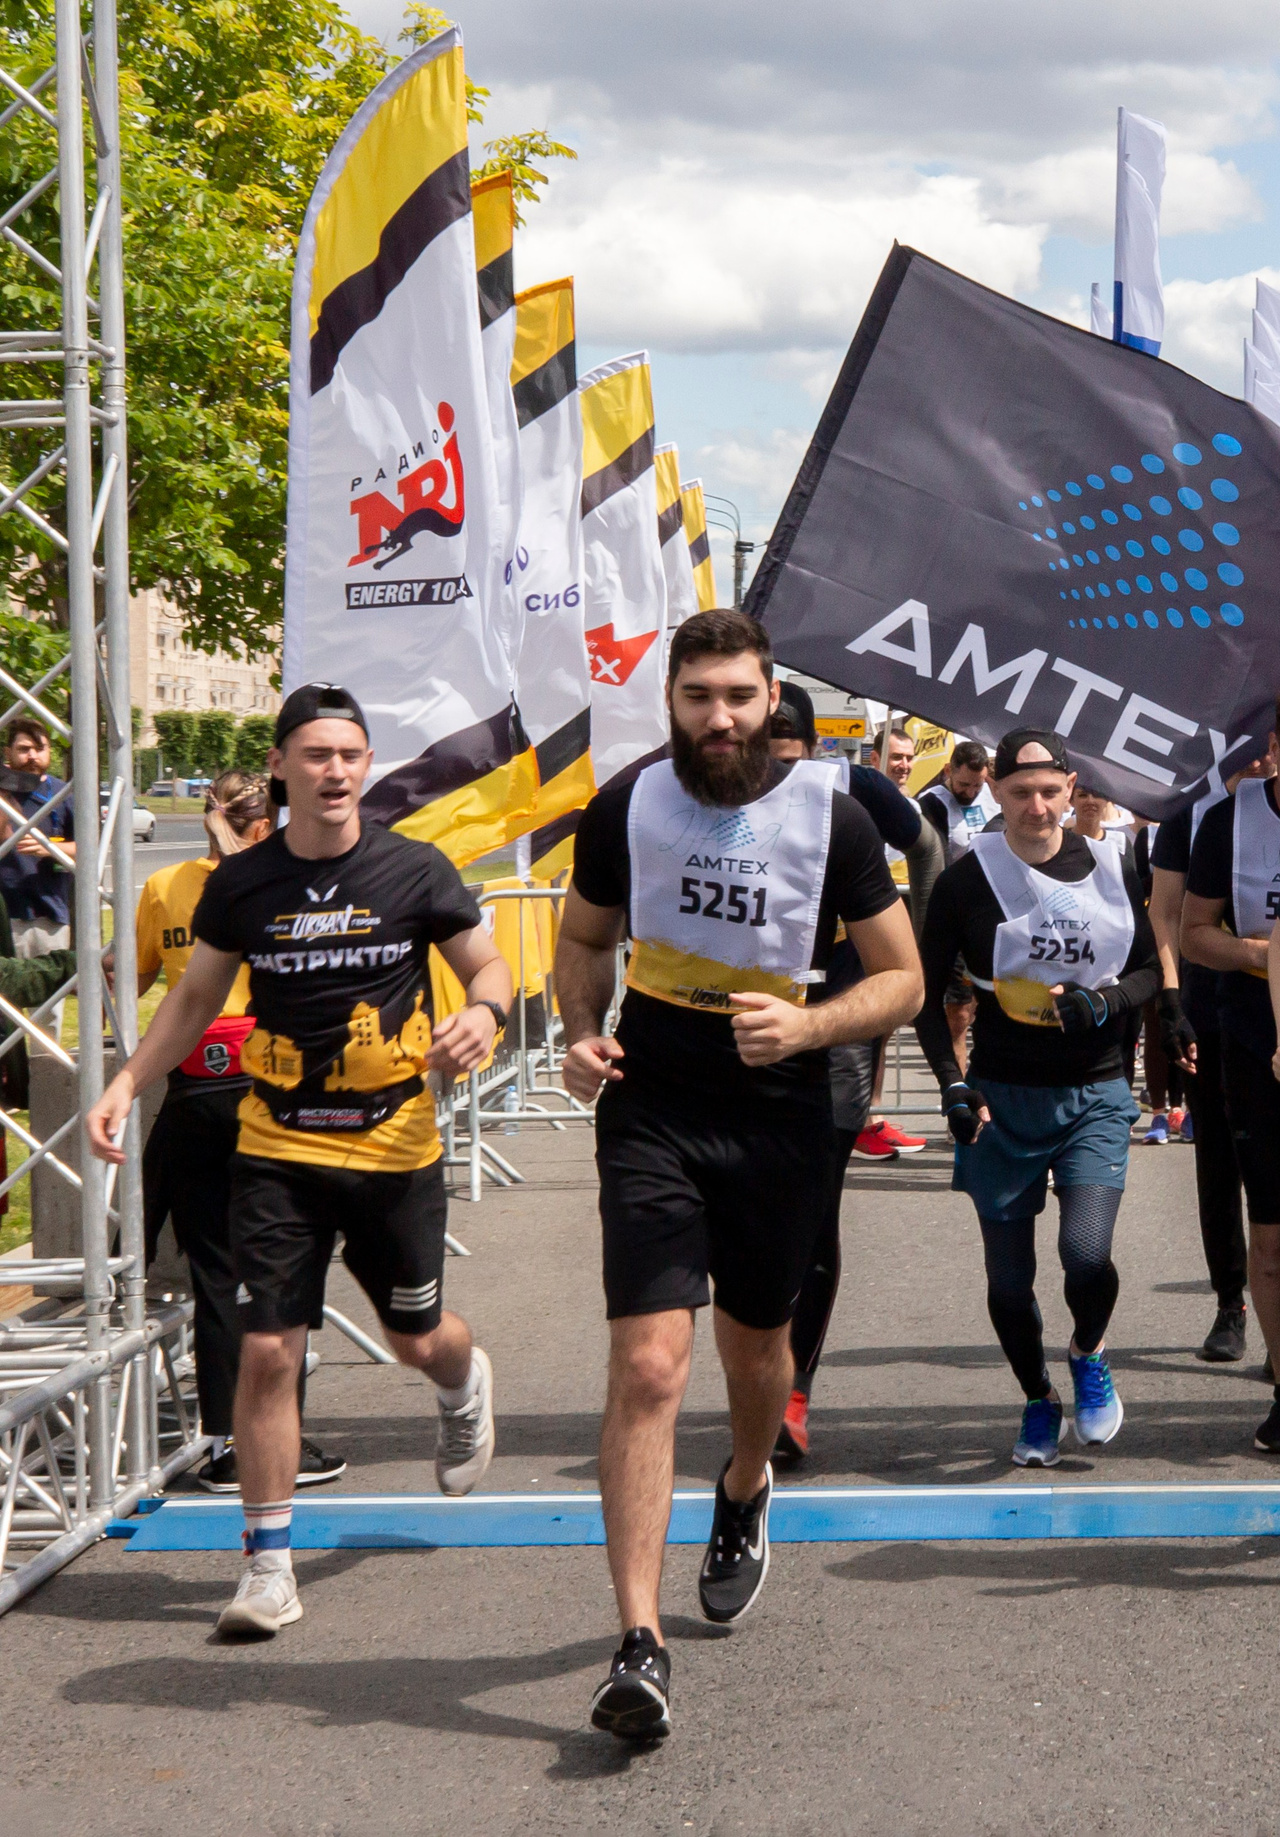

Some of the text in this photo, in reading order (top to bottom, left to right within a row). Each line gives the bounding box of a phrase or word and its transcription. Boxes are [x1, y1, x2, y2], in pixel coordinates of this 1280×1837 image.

[350, 428, 439, 492] РАДИО
[350, 583, 426, 606] ENERGY
[845, 599, 1252, 796] AMTEX
[686, 854, 769, 875] AMTEX
[679, 877, 767, 926] 5251
[291, 904, 353, 941] URBAN
[1040, 920, 1091, 931] AMTEX
[1029, 935, 1096, 965] 5254
